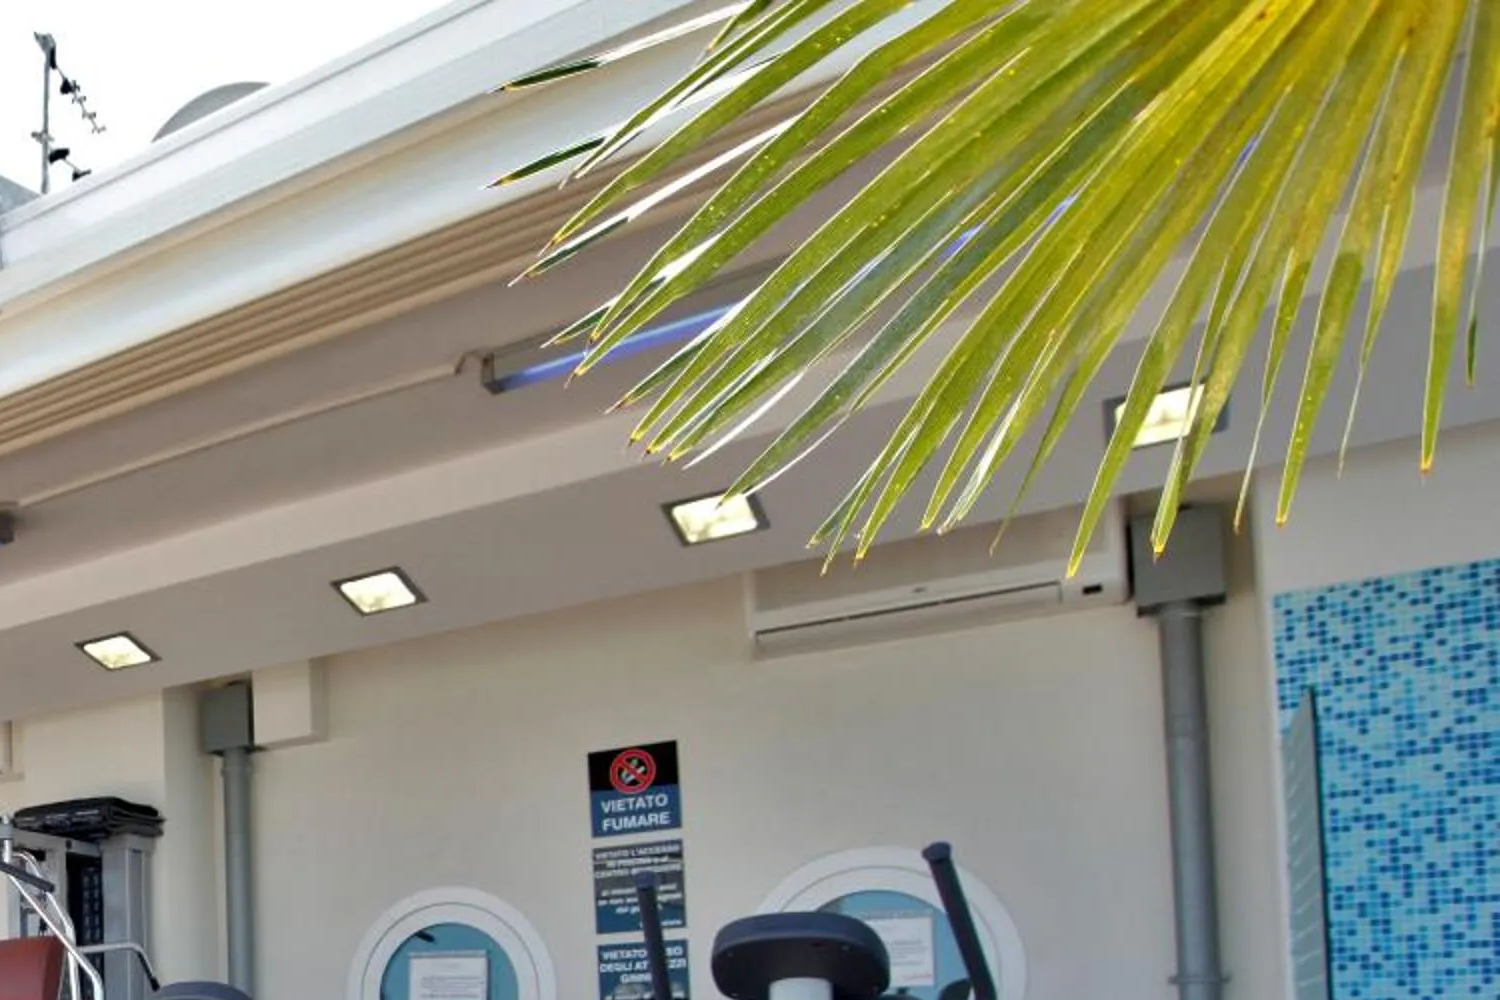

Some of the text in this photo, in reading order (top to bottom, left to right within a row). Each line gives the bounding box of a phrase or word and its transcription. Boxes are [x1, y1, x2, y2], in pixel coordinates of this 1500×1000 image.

[601, 793, 668, 813] VIETATO
[603, 812, 670, 831] FUMARE
[602, 949, 647, 960] VIETATO
